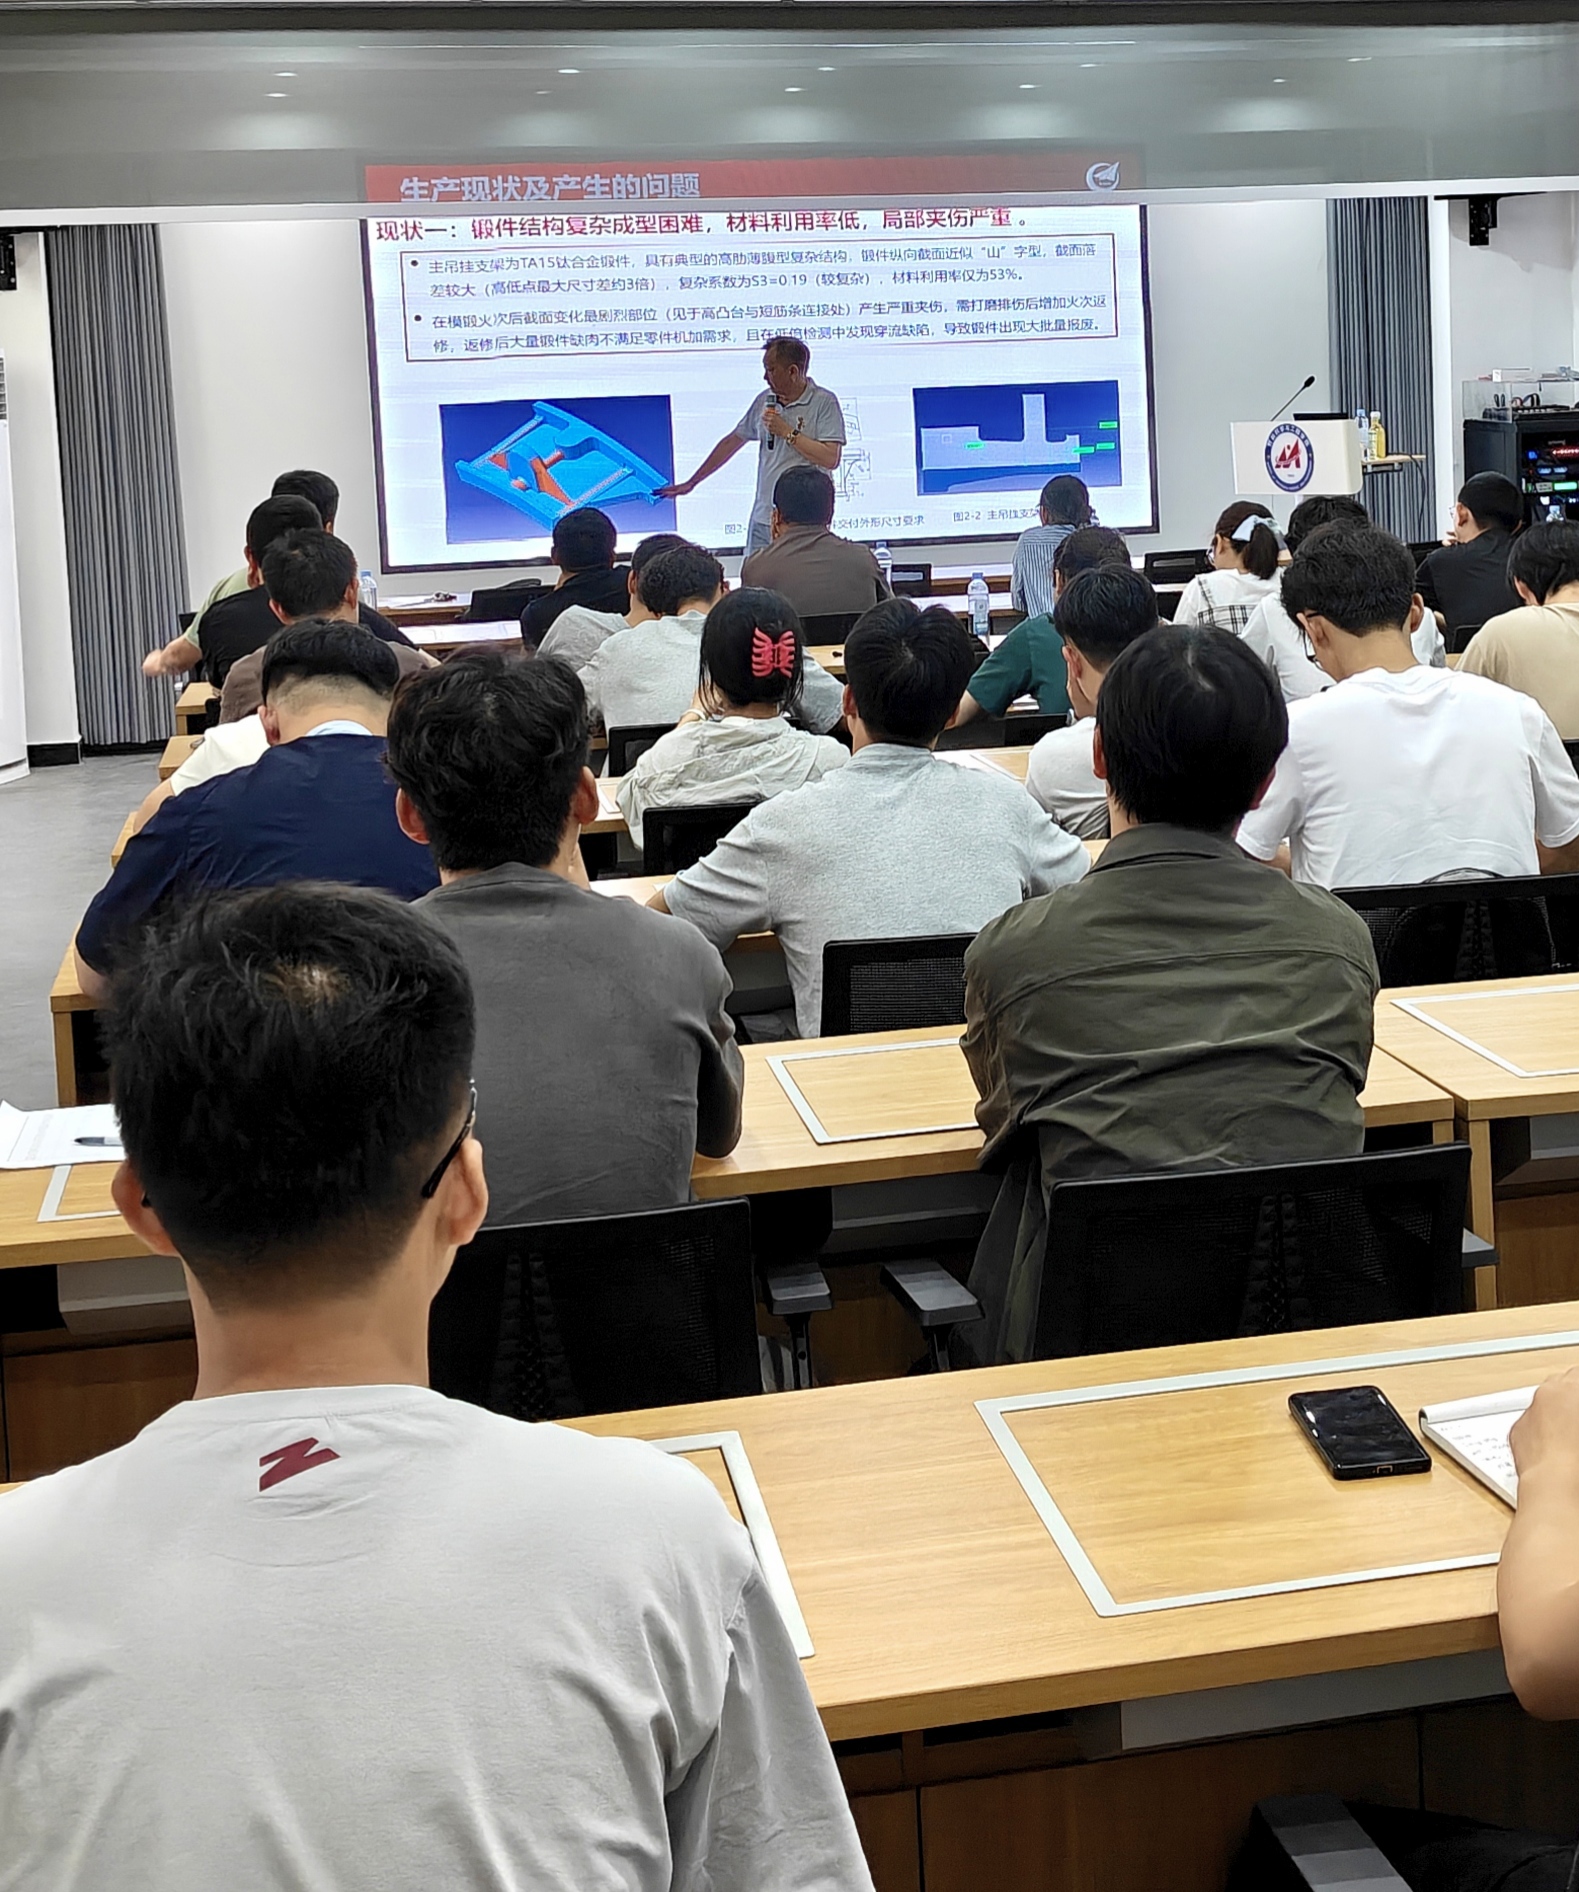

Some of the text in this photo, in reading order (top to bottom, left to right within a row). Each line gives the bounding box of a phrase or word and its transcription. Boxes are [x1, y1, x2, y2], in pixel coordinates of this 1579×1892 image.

[400, 172, 701, 201] 生产现状及产生的问题
[376, 208, 1028, 241] 现状一：锻件结构复杂成型困难，材料利用率低，局部夹伤严重。
[954, 511, 981, 522] 图2-2
[725, 523, 747, 534] 图2-
